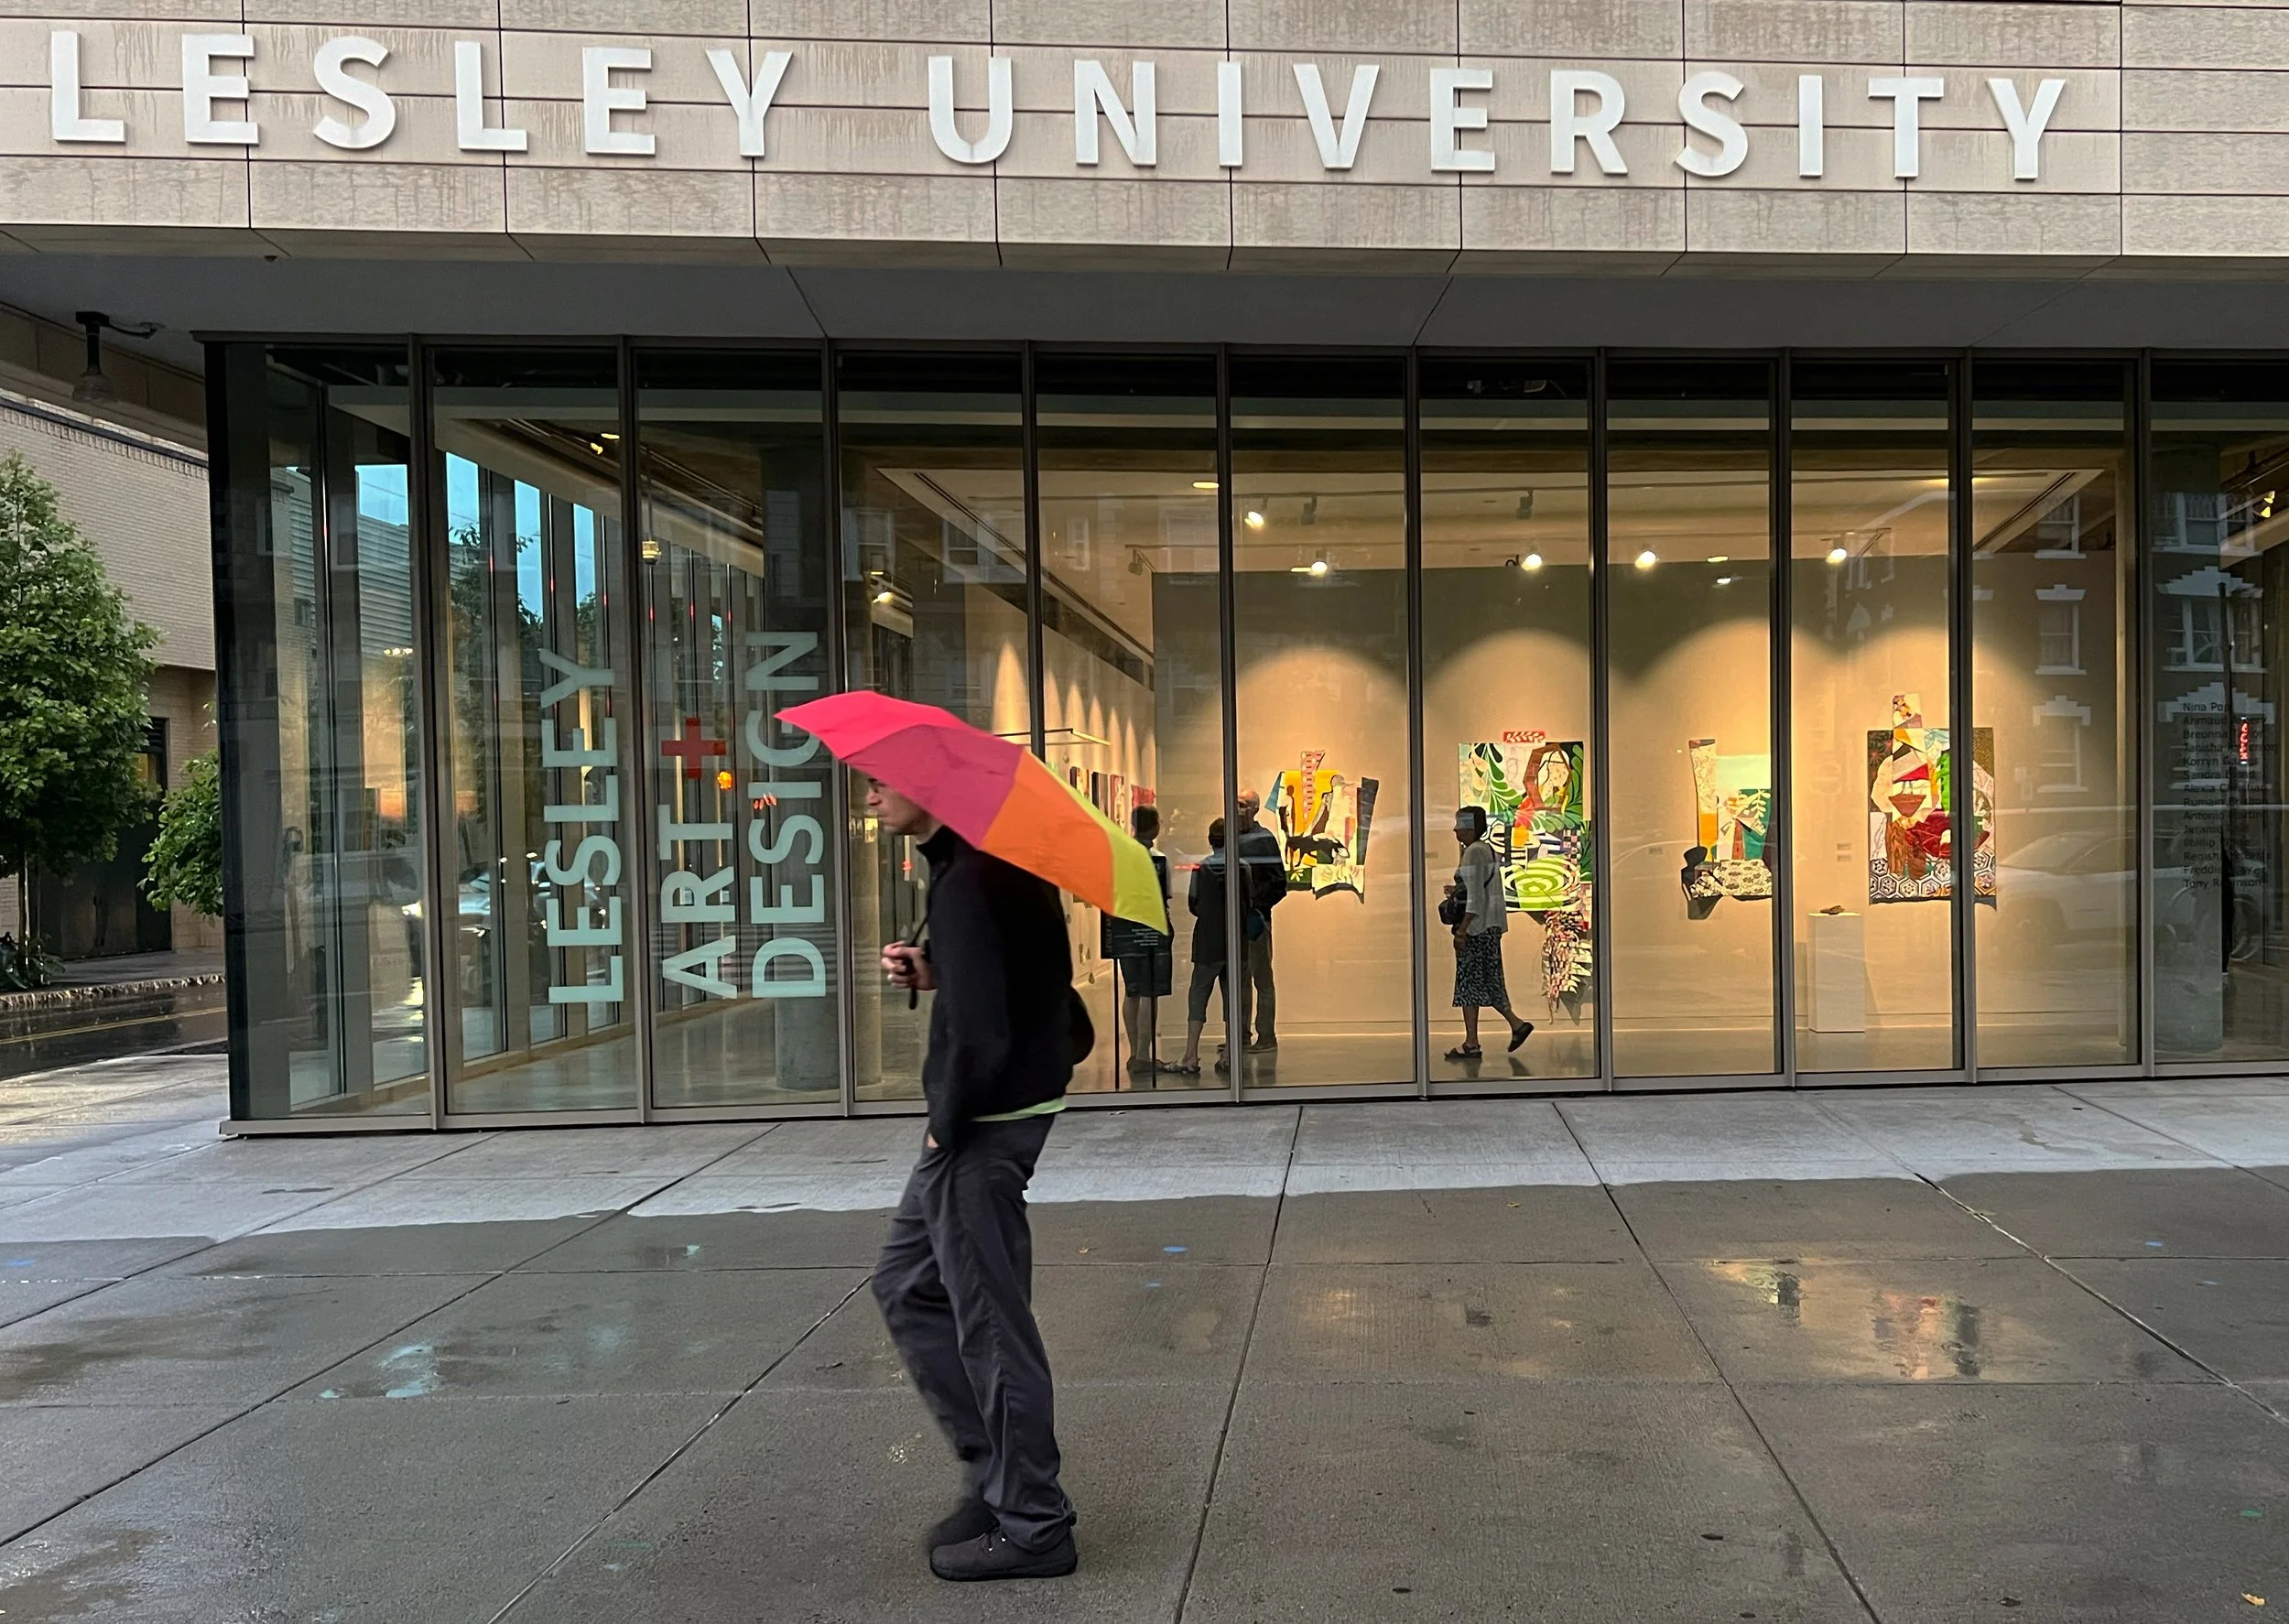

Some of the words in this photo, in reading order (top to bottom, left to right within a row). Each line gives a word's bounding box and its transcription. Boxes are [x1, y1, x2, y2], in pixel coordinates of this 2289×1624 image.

[50, 30, 793, 158] LESLEY
[928, 55, 2067, 181] UNIVERSITY
[2183, 703, 2207, 711] Nina
[539, 648, 624, 1003] LESLEY
[658, 804, 737, 999] ART
[745, 632, 826, 998] DESIGN
[2184, 851, 2221, 861] Renish
